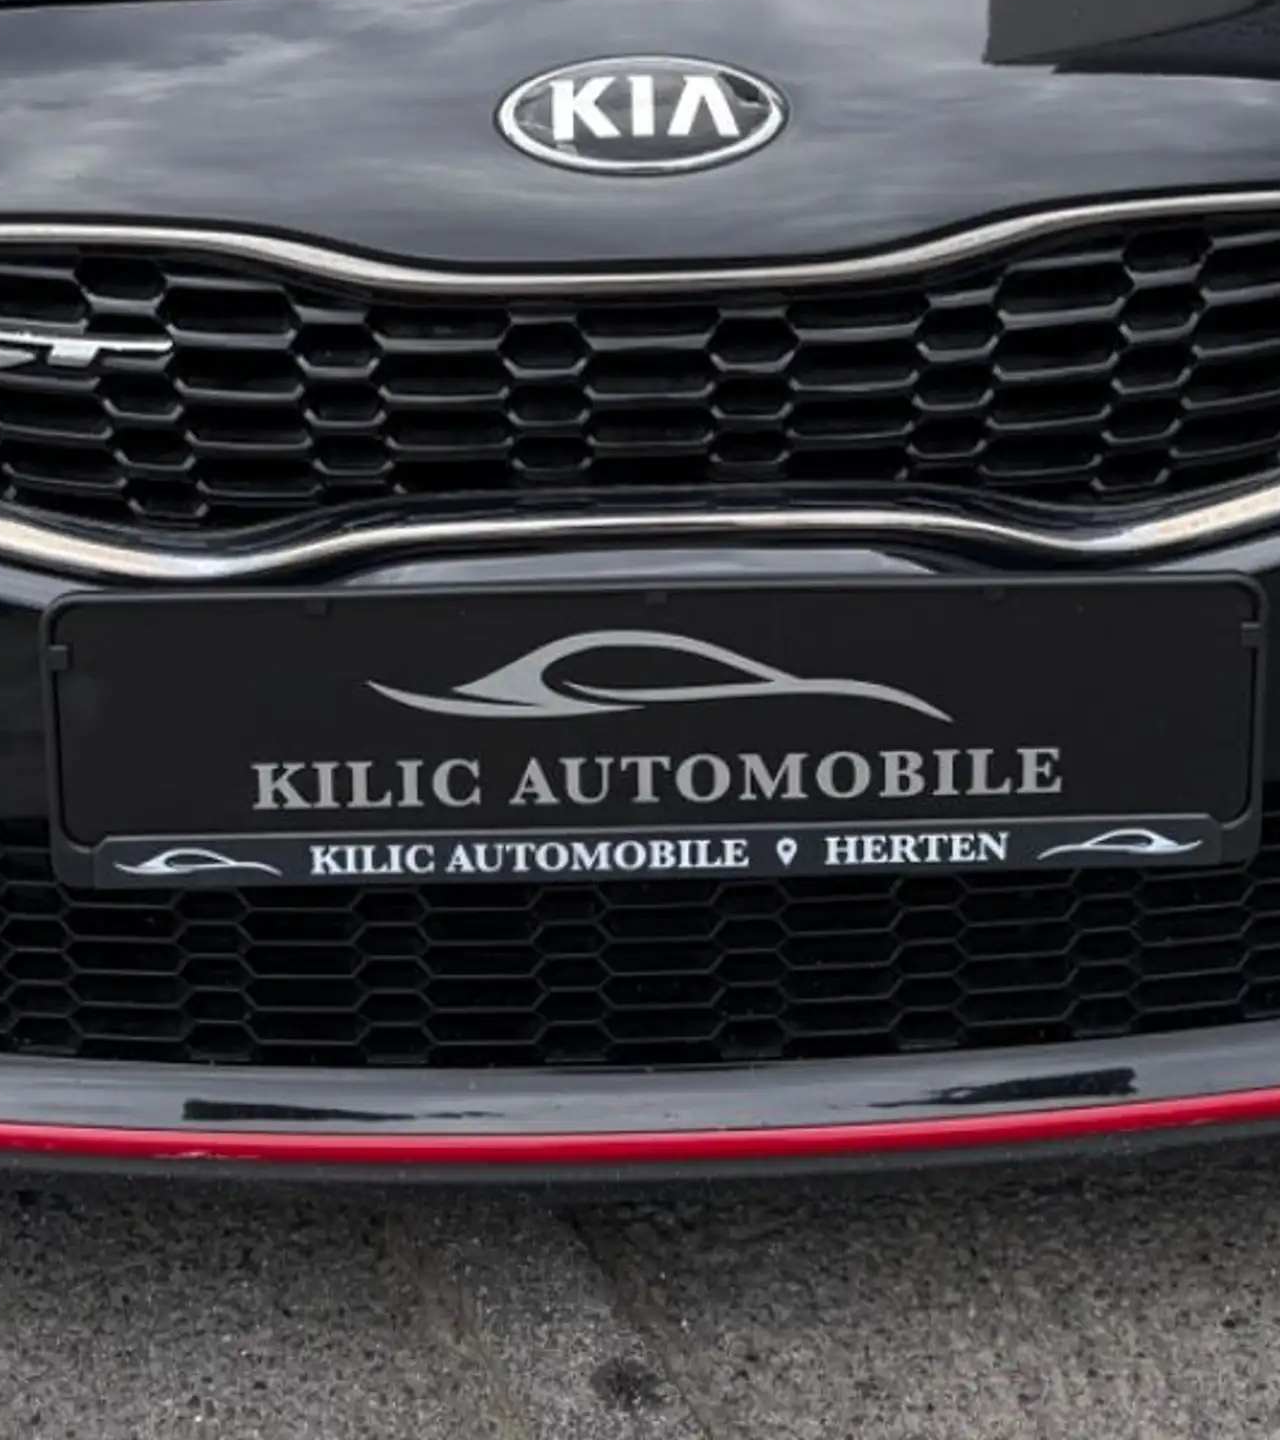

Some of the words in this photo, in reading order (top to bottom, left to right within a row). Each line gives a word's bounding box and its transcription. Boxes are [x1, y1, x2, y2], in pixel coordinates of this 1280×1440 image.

[548, 73, 741, 141] KIA
[250, 758, 482, 811] KILIC
[508, 747, 1063, 807] AUTOMOBILE
[308, 844, 437, 876] KILIC
[446, 837, 750, 875] AUTOMOBILE
[823, 830, 1010, 867] HERTEN
